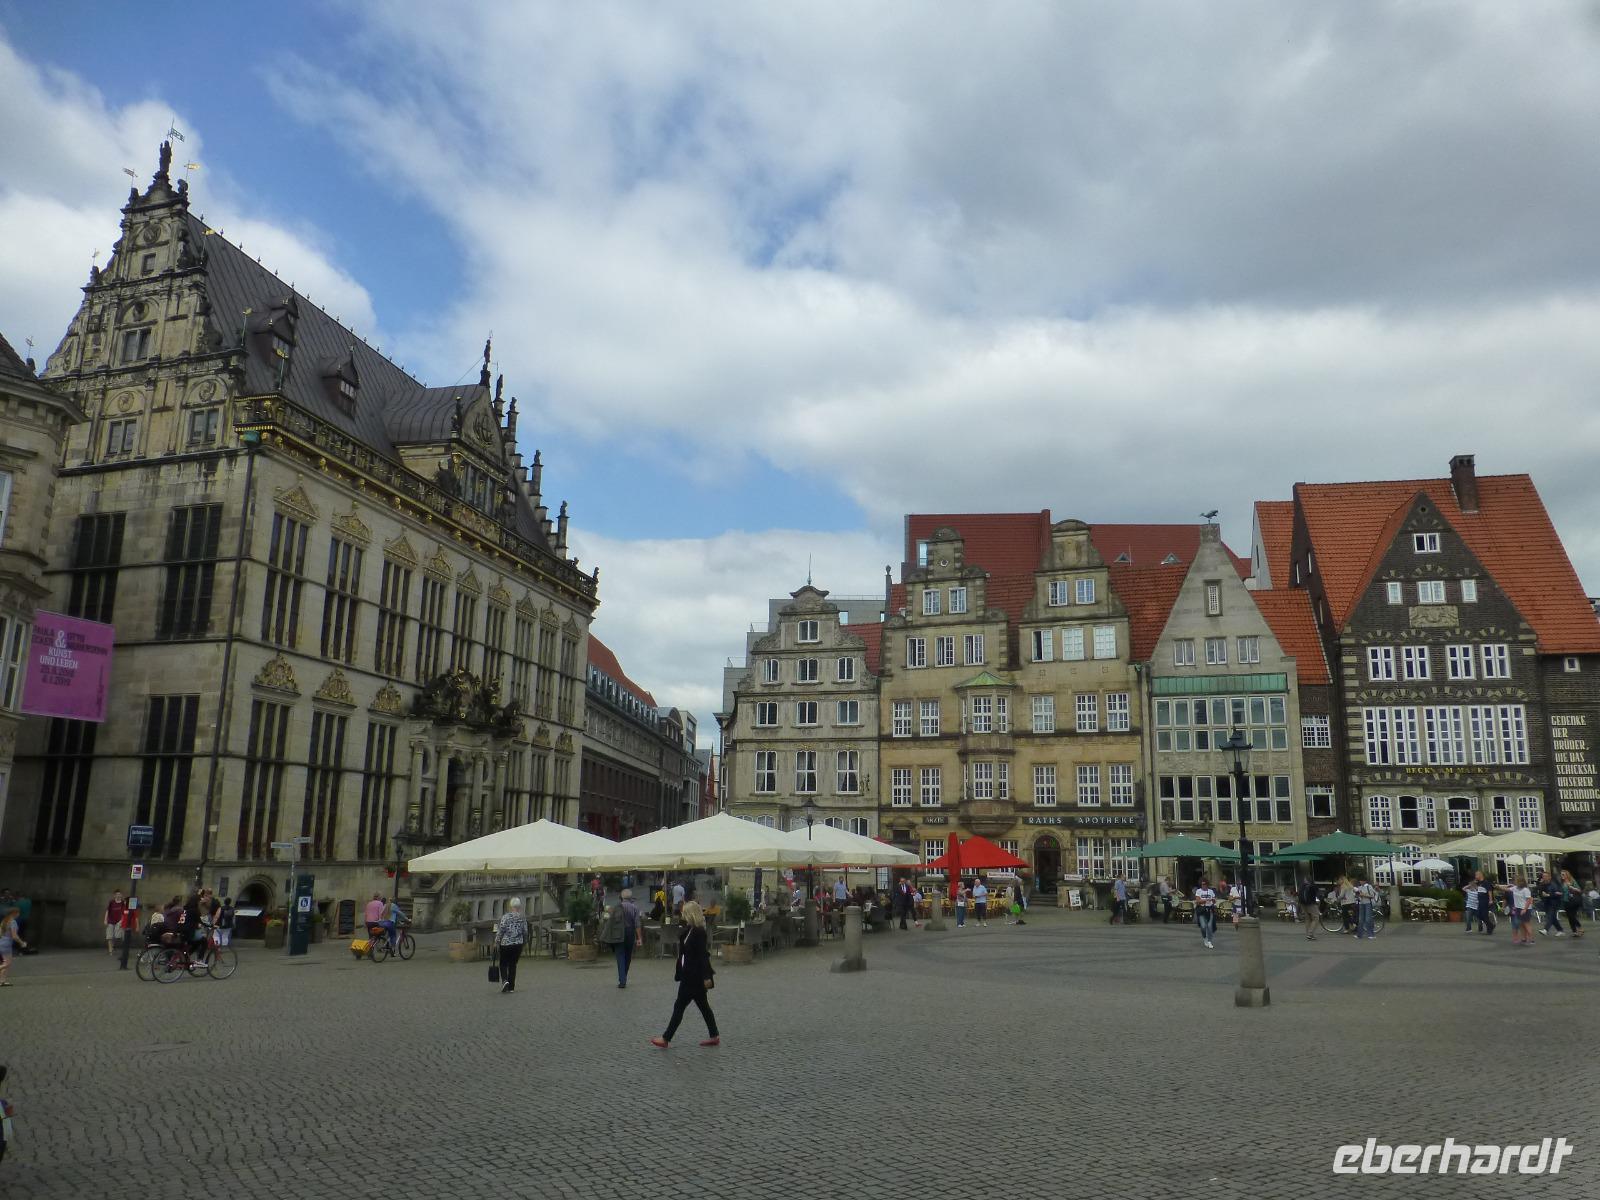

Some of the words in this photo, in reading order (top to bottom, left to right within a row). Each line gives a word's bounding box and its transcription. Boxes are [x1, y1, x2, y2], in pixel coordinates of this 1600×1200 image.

[48, 647, 72, 659] KUNST
[40, 655, 55, 666] UND
[56, 657, 78, 669] LEBEN
[1552, 727, 1568, 738] DER
[1555, 752, 1568, 763] DIE
[1569, 752, 1585, 763] DAS
[1556, 764, 1598, 775] SCHICKSAL
[1557, 776, 1594, 787] UNSERER
